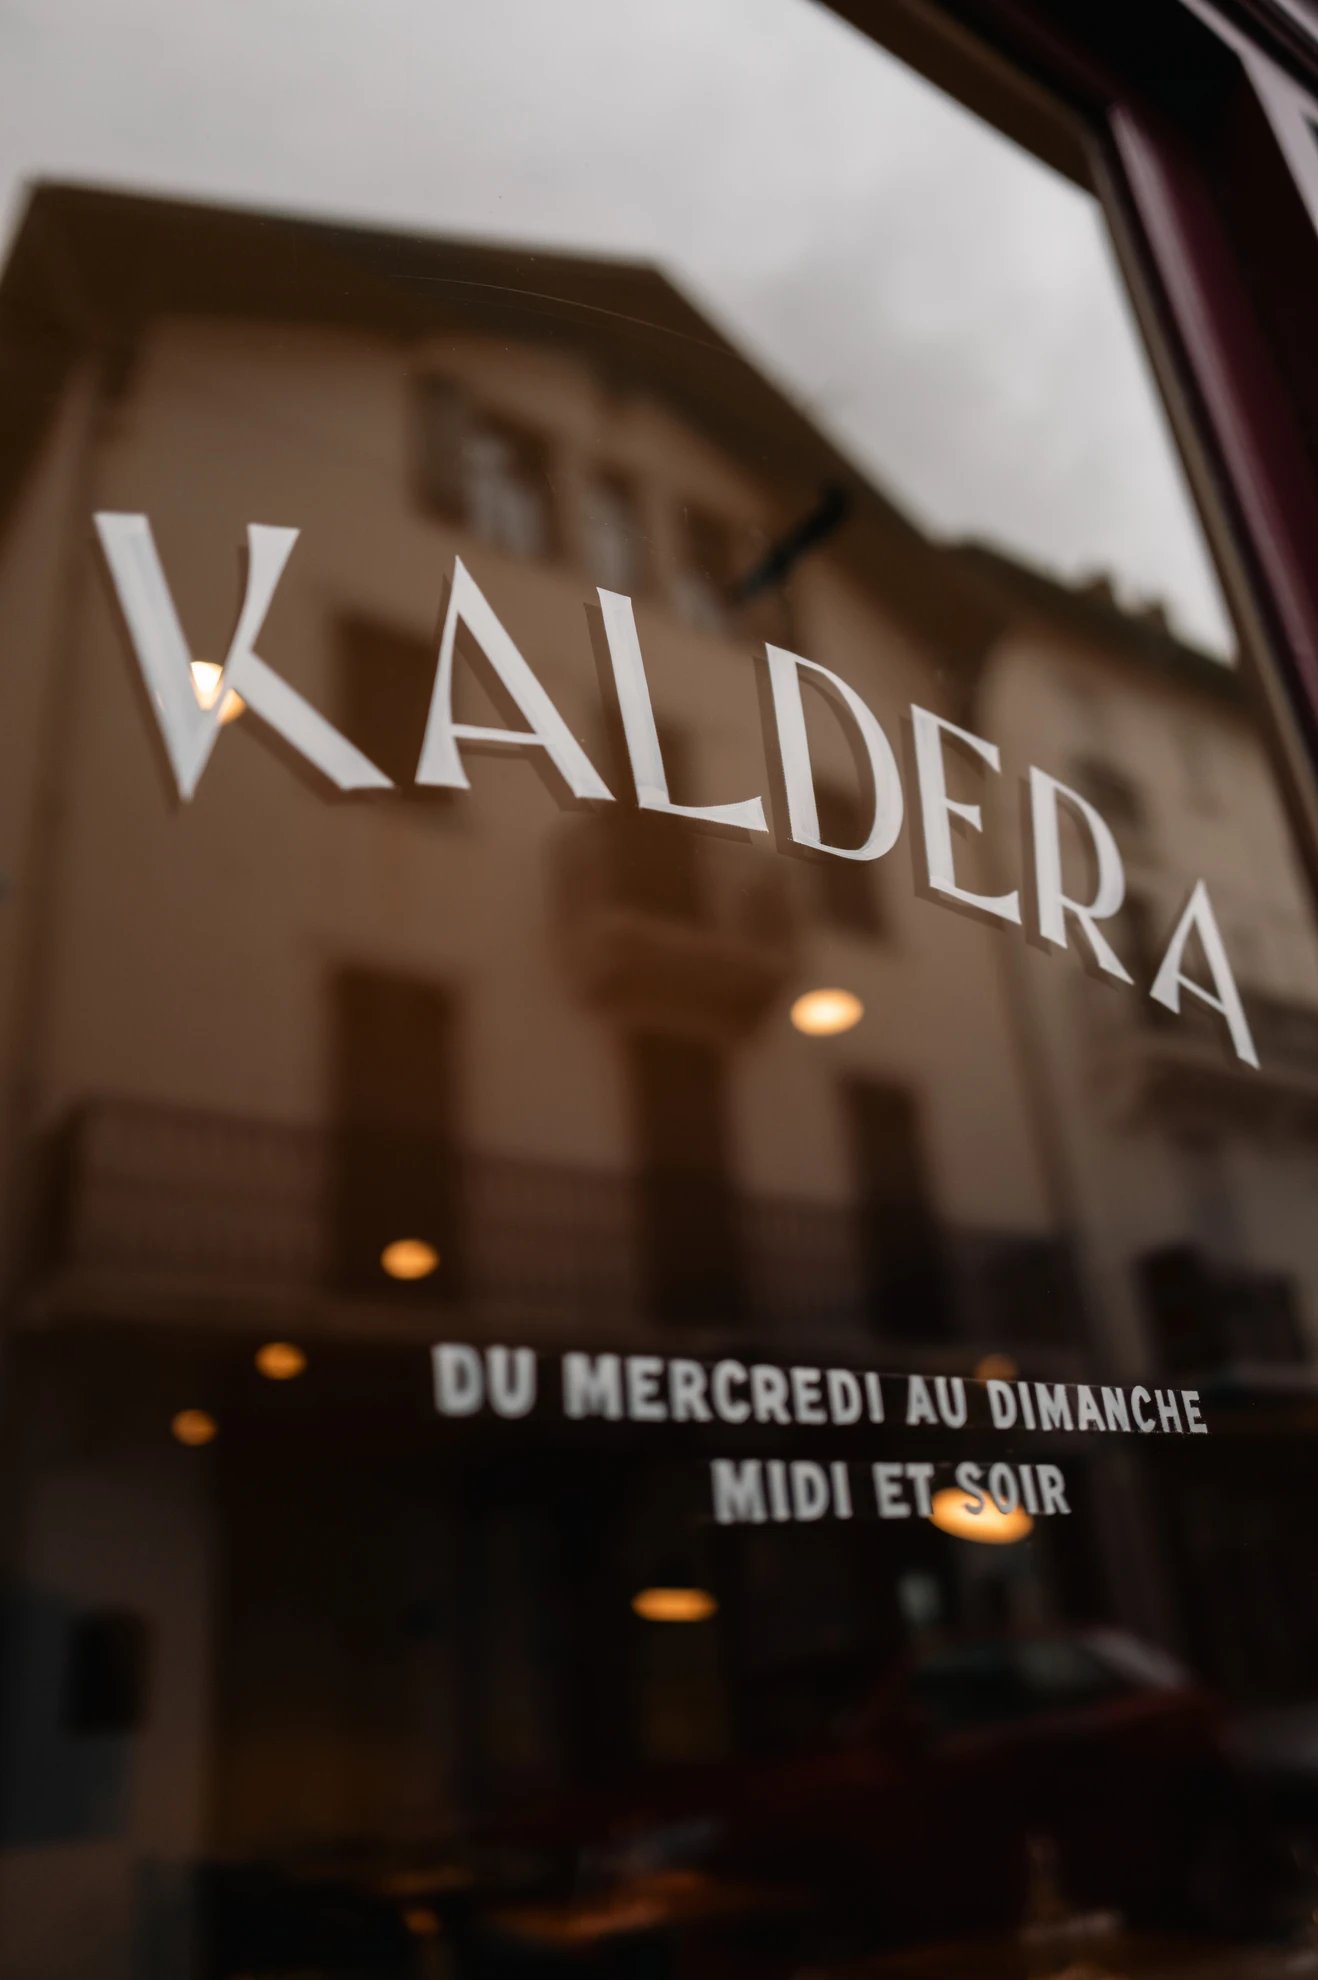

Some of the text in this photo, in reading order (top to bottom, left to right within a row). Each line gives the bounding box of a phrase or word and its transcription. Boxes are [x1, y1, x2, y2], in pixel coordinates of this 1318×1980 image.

[94, 512, 1261, 1070] KALDERA
[431, 1342, 1208, 1433] DU MERCREDI AU DIMANCHE
[710, 1458, 1071, 1524] MIDI ET SOIR
